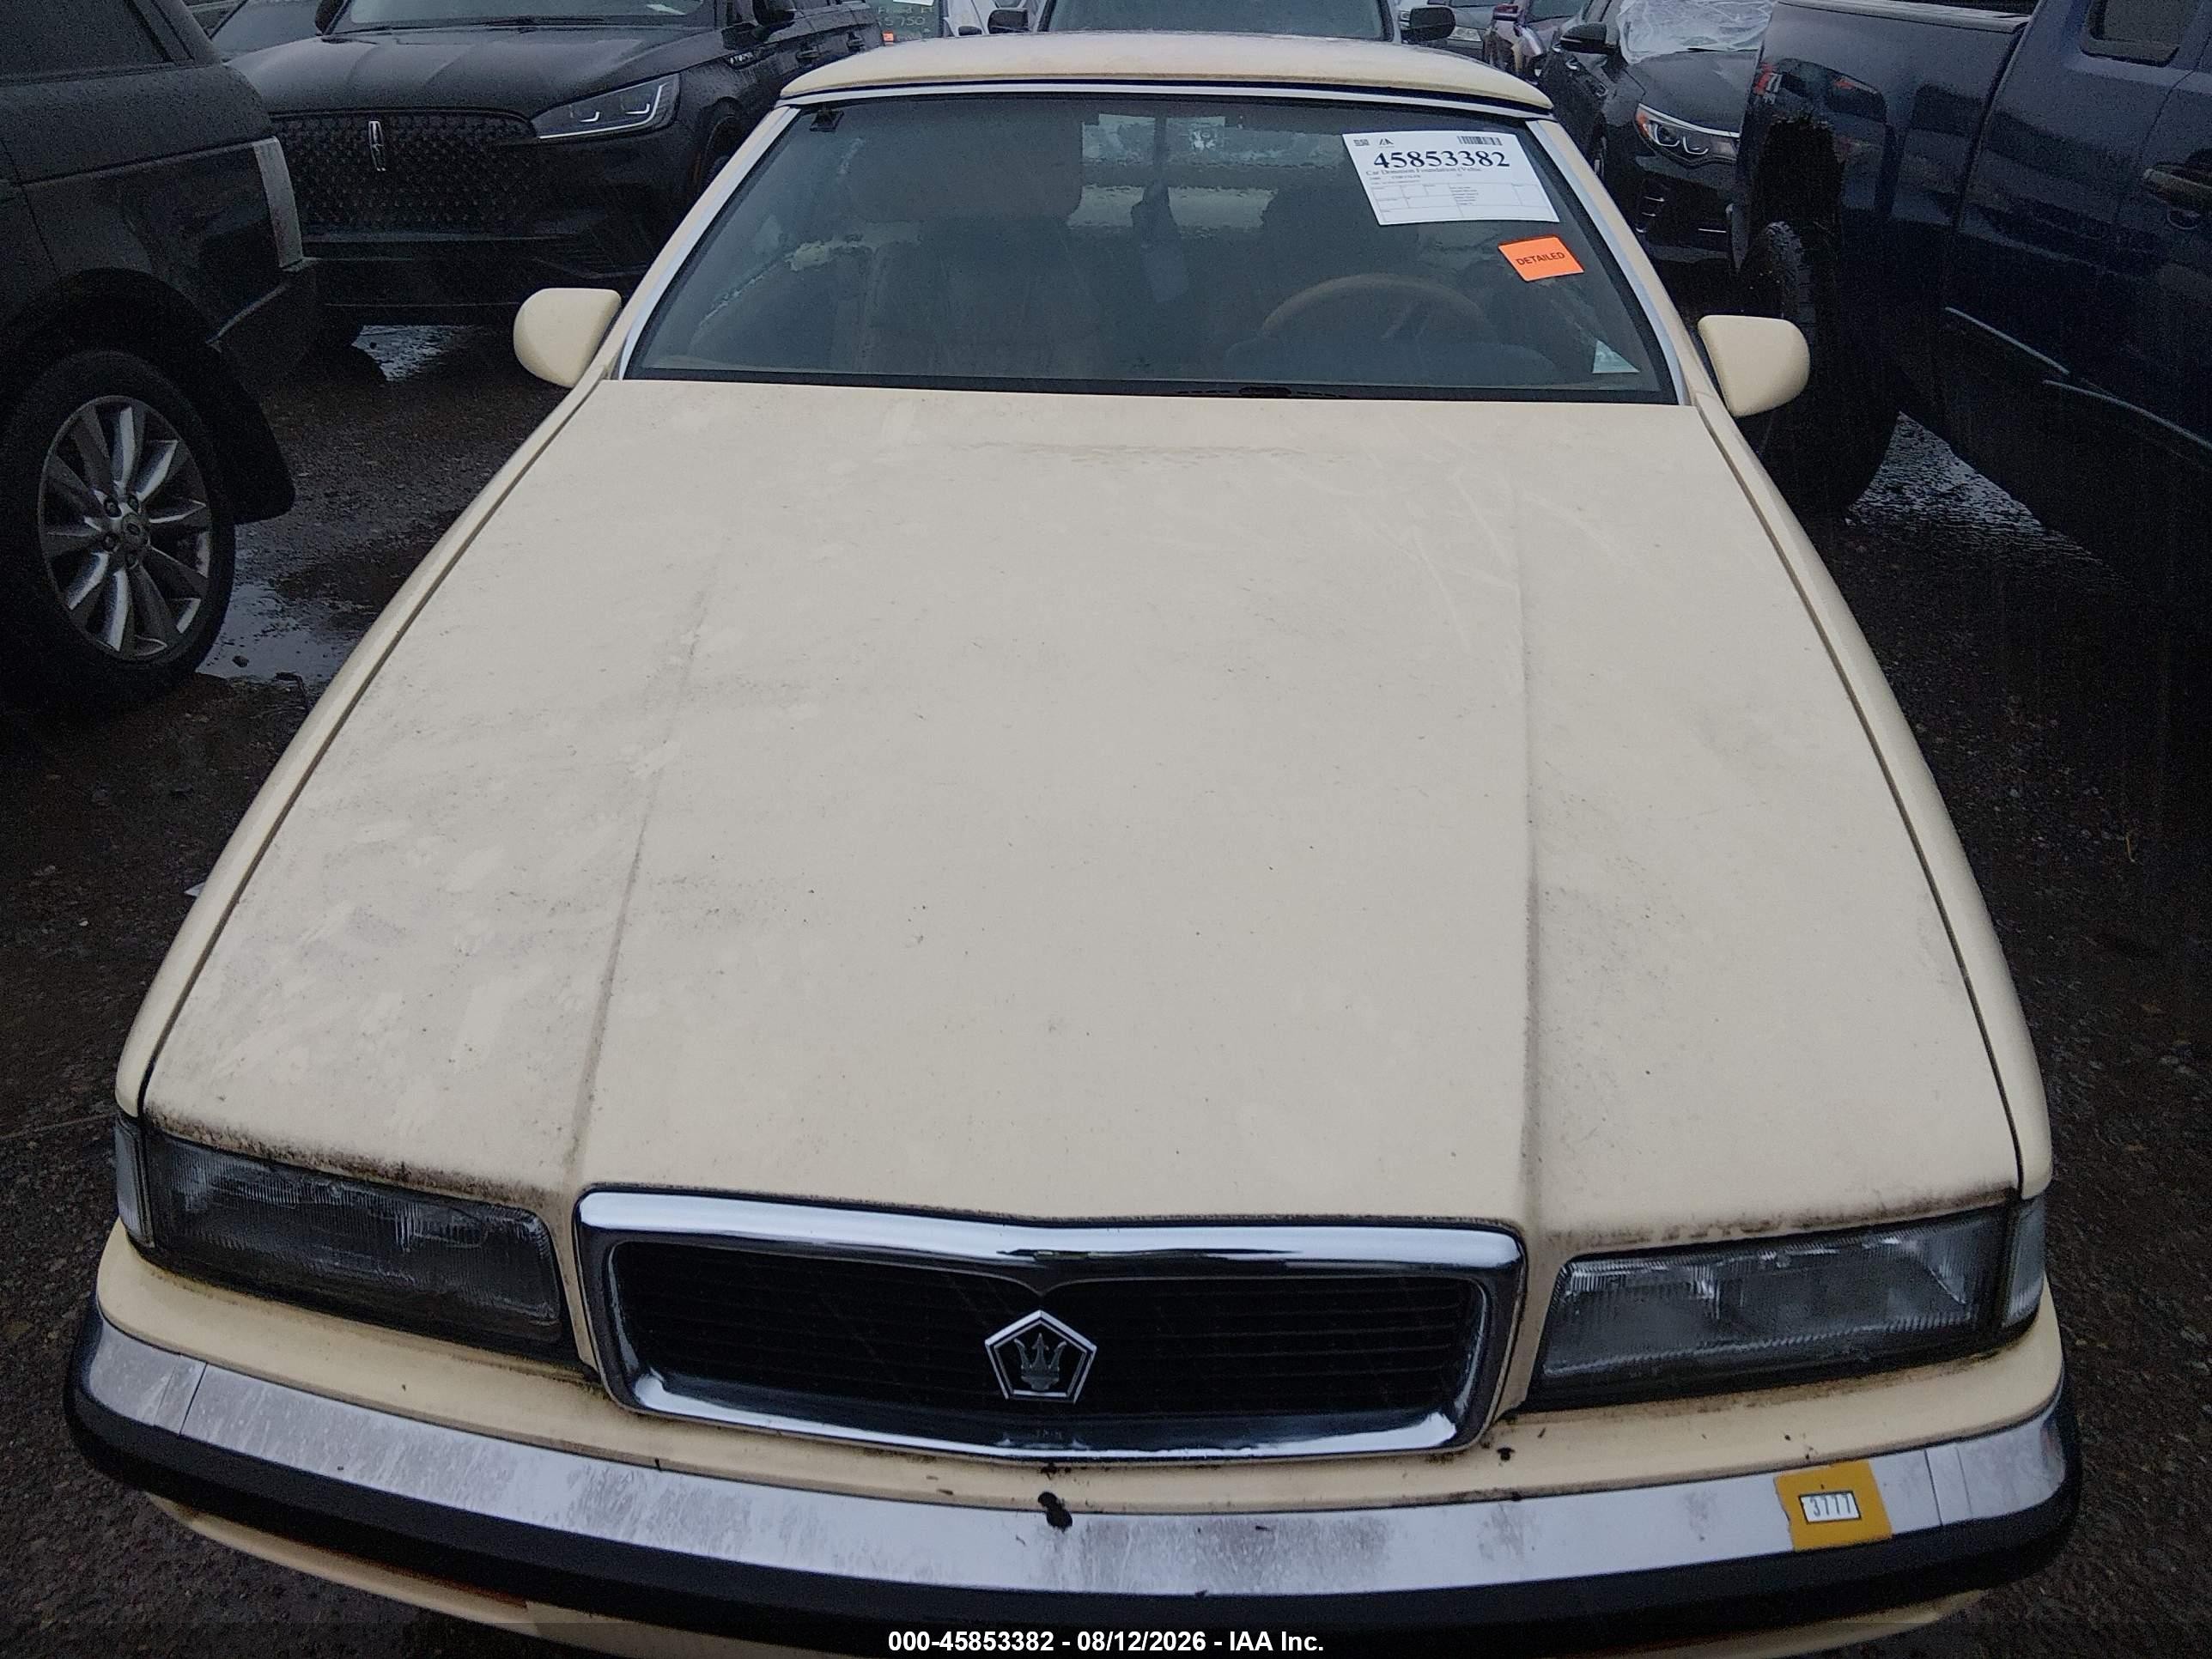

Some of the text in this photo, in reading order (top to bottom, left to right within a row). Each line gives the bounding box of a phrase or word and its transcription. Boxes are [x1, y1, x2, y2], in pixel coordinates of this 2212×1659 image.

[1374, 150, 1510, 168] 45853382
[1516, 252, 1565, 265] DETAILED
[1810, 1493, 1851, 1517] 3777
